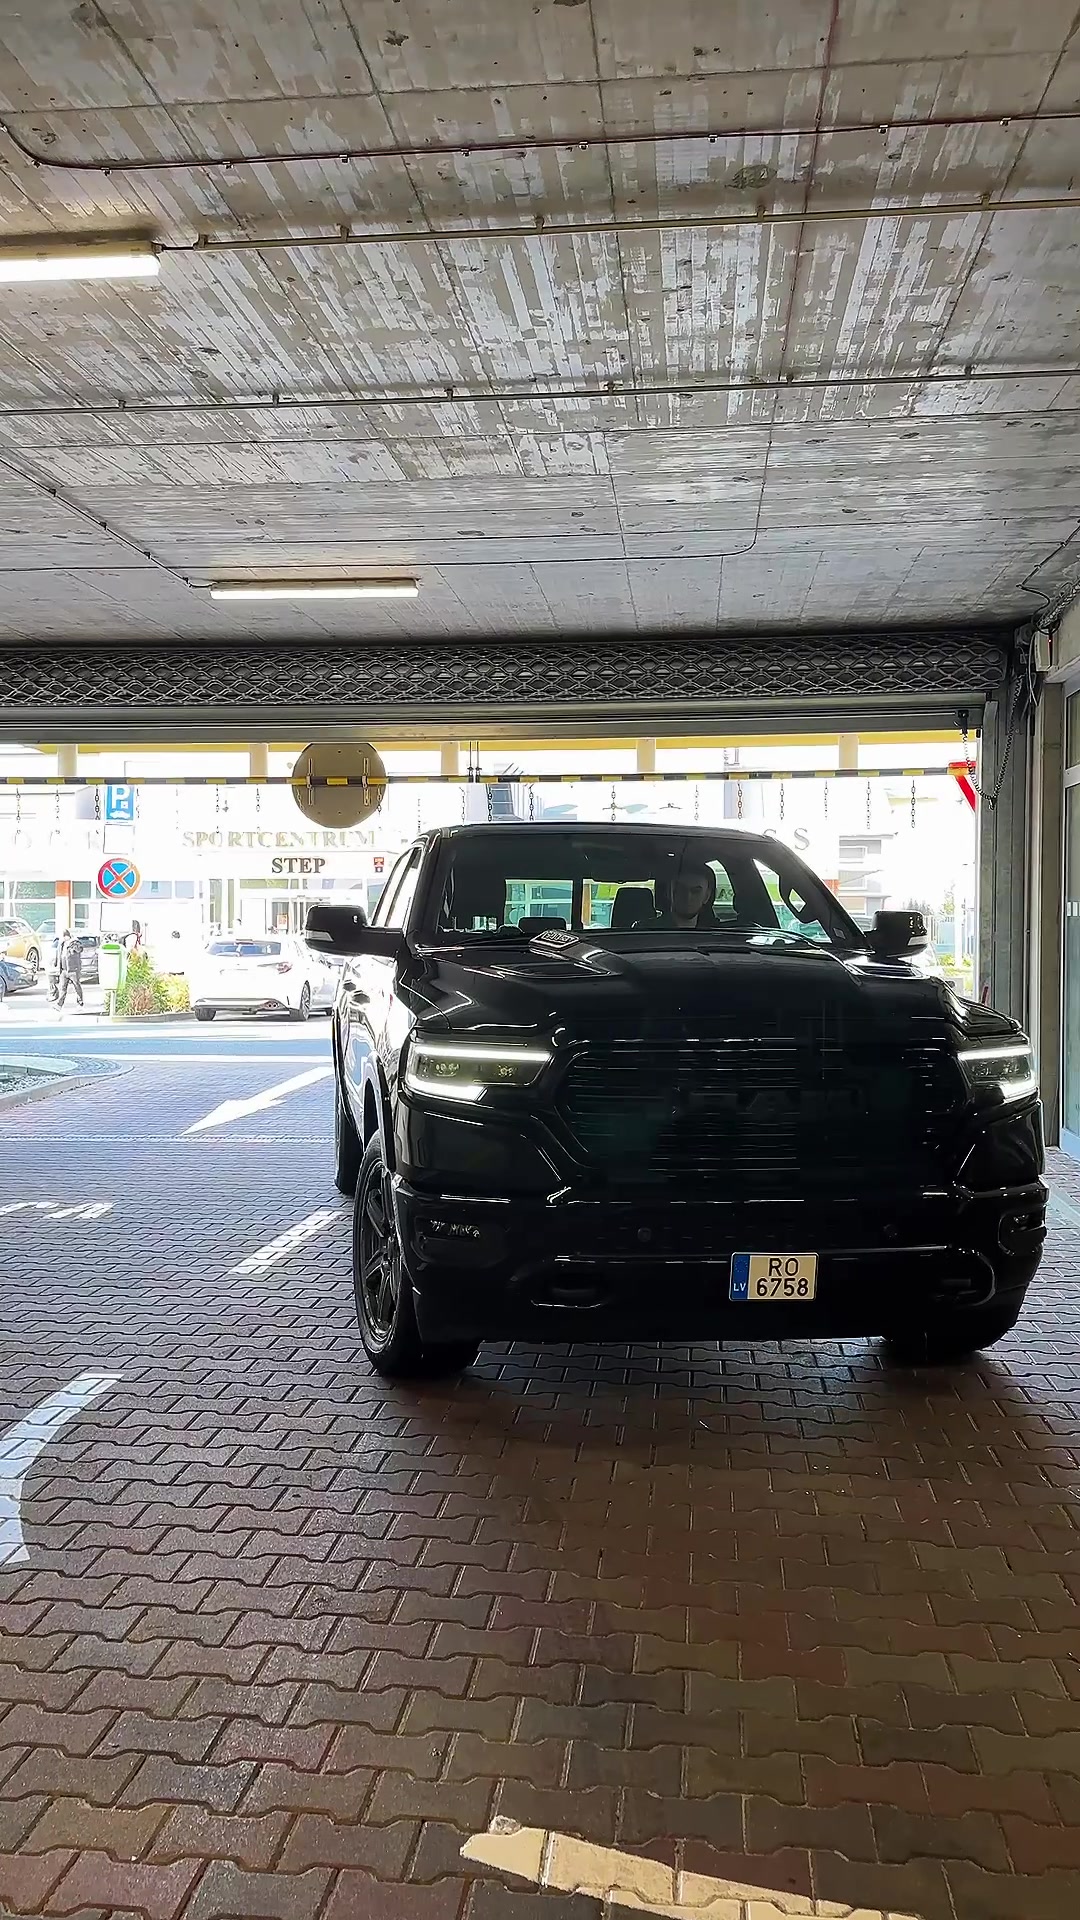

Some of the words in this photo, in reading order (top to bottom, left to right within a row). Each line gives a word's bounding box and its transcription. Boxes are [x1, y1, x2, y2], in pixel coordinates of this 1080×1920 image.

[111, 785, 131, 809] P
[271, 857, 326, 874] STEP
[768, 1257, 799, 1277] RO
[733, 1282, 747, 1292] LV
[756, 1277, 809, 1297] 6758
